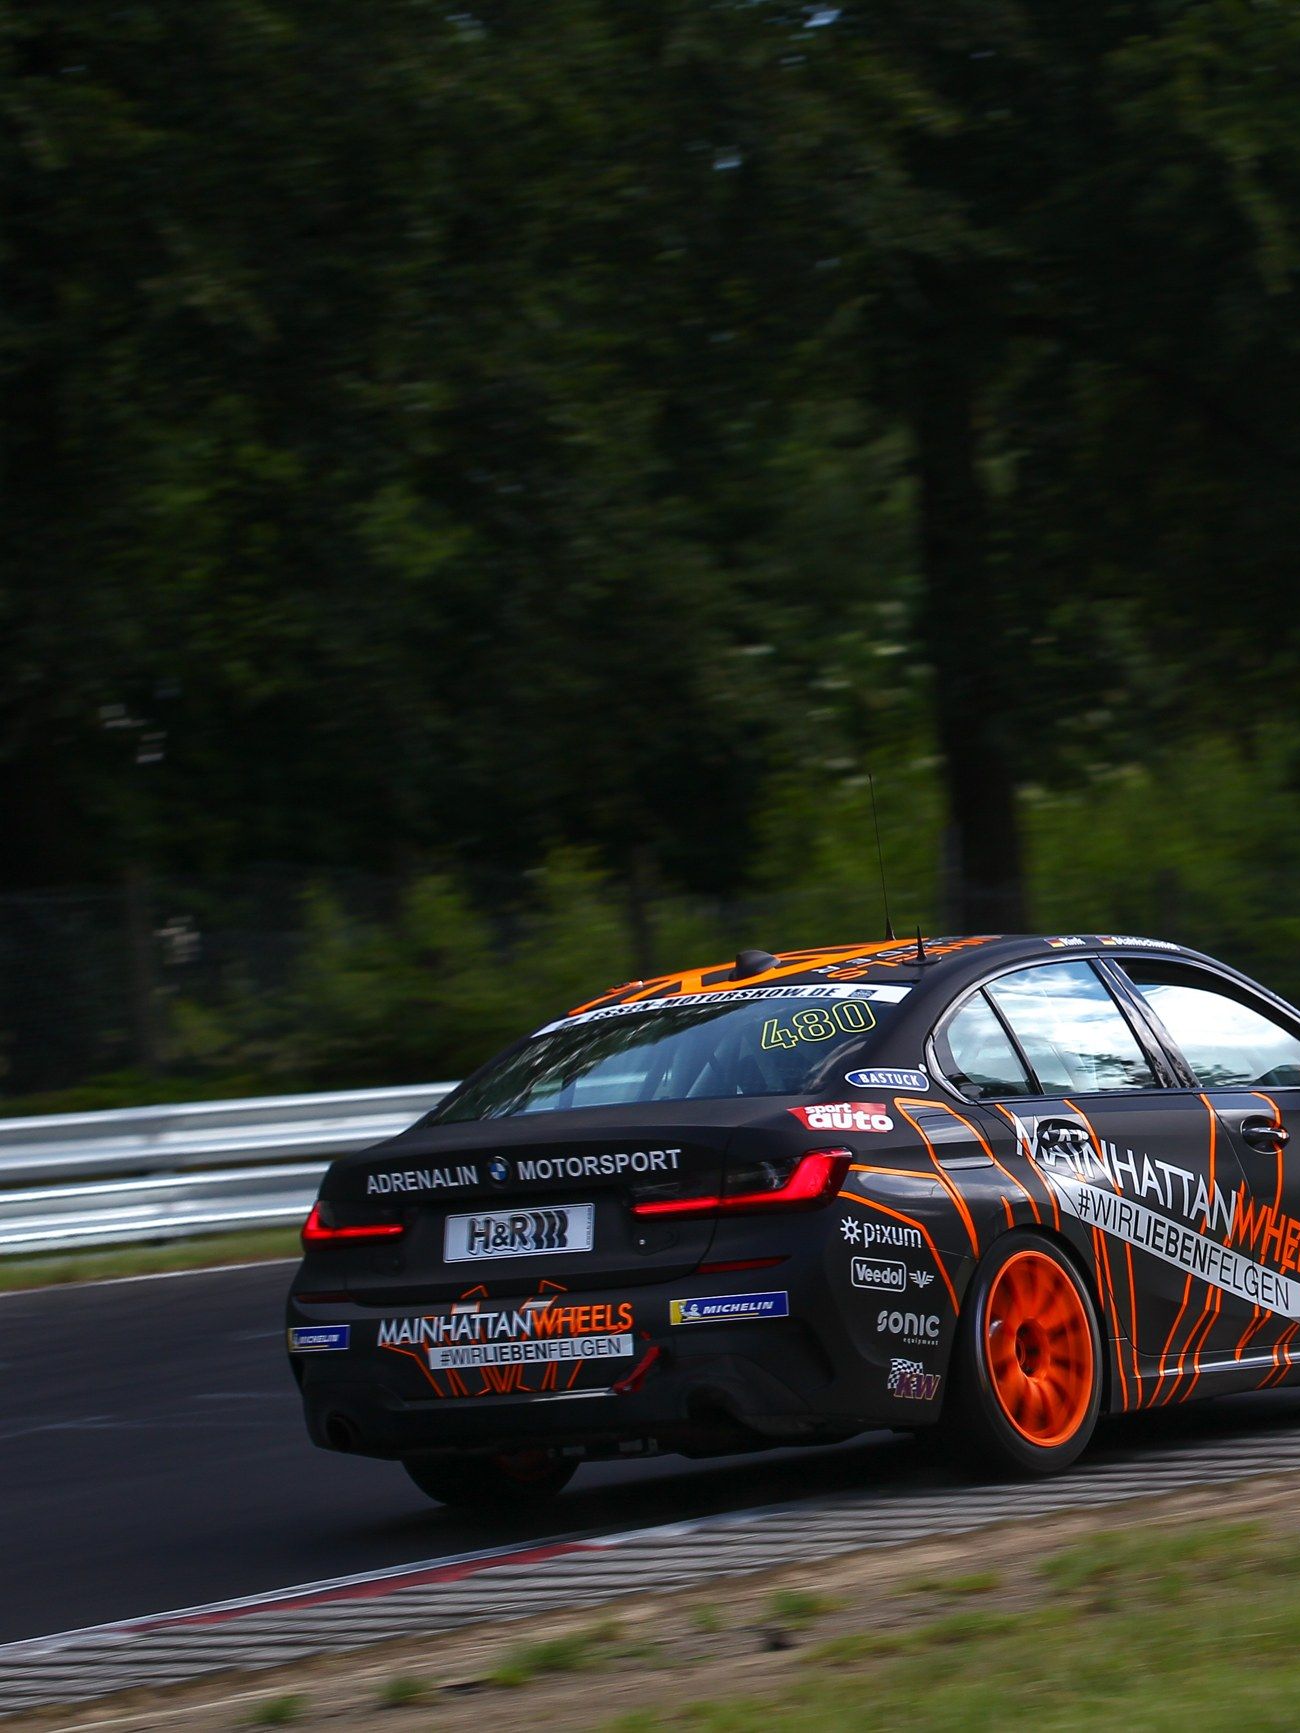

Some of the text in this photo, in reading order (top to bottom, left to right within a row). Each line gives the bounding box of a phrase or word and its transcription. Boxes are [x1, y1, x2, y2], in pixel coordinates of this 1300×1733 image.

[761, 1000, 877, 1050] 480
[857, 1073, 921, 1087] BASTUCK
[804, 1102, 852, 1115] sport
[807, 1110, 895, 1132] auto
[366, 1149, 682, 1195] ADRENALIN MOTORSPORT
[468, 1212, 531, 1255] H&R
[863, 1222, 922, 1249] pixum
[1078, 1186, 1290, 1311] #WIRLIEBENFELGEN
[855, 1263, 903, 1286] Veedol
[702, 1301, 774, 1315] MICHELIN
[440, 1338, 622, 1366] #WIRLIEBENFELGEN
[893, 1372, 942, 1401] KW
